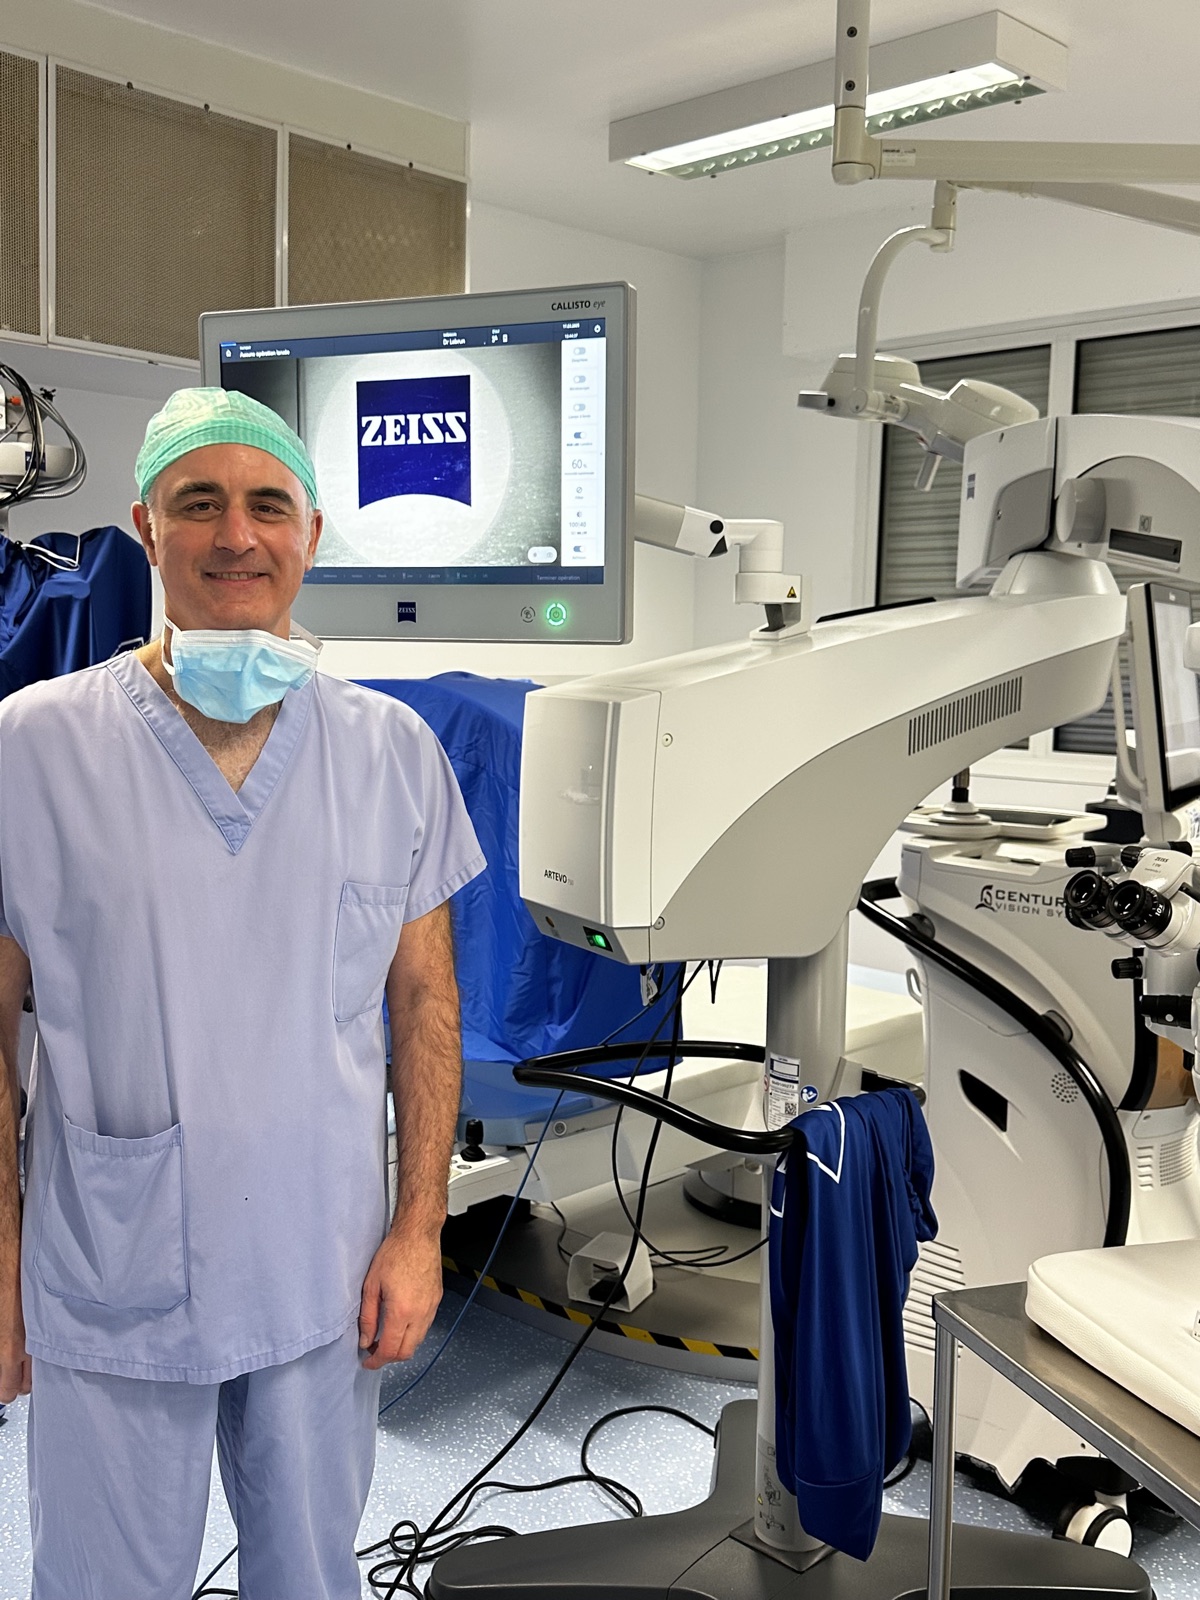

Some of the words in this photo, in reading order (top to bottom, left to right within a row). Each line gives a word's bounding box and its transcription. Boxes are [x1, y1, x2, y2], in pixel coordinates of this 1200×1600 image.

[551, 300, 591, 311] CALLISTO
[593, 300, 606, 311] eye
[361, 411, 467, 447] ZEISS
[543, 869, 568, 884] ARTEVO
[995, 889, 1066, 908] CENTUR
[995, 902, 1040, 915] VISION
[1046, 908, 1065, 918] SY
